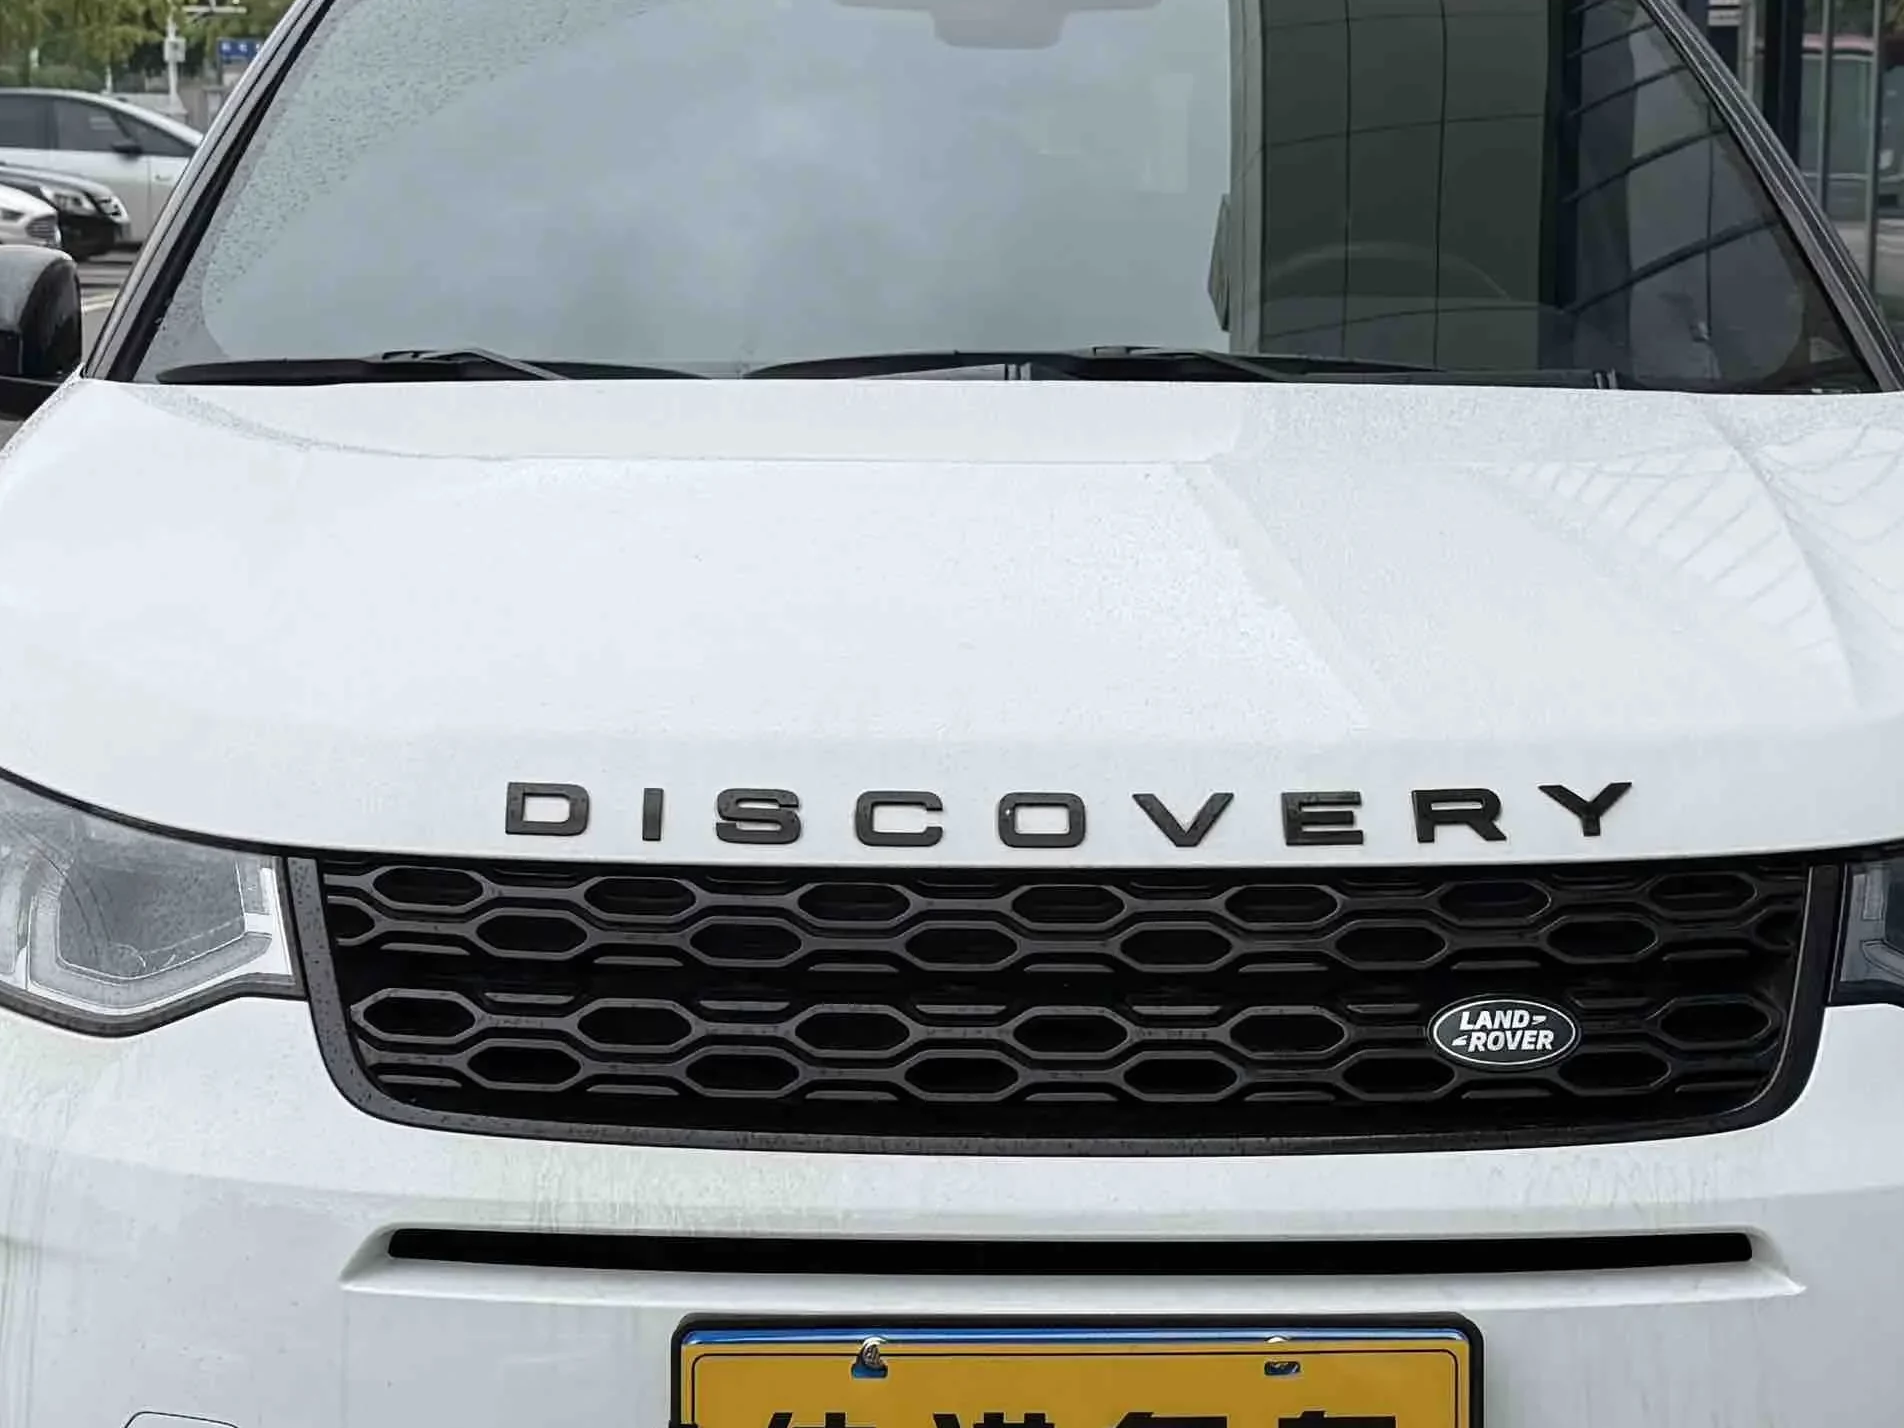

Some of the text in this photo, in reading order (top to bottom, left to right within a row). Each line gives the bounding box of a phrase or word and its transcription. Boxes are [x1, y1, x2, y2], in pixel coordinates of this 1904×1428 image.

[504, 781, 1633, 849] DISCOVERY
[1459, 1009, 1530, 1031] LAND
[1467, 1029, 1555, 1053] ROVER
